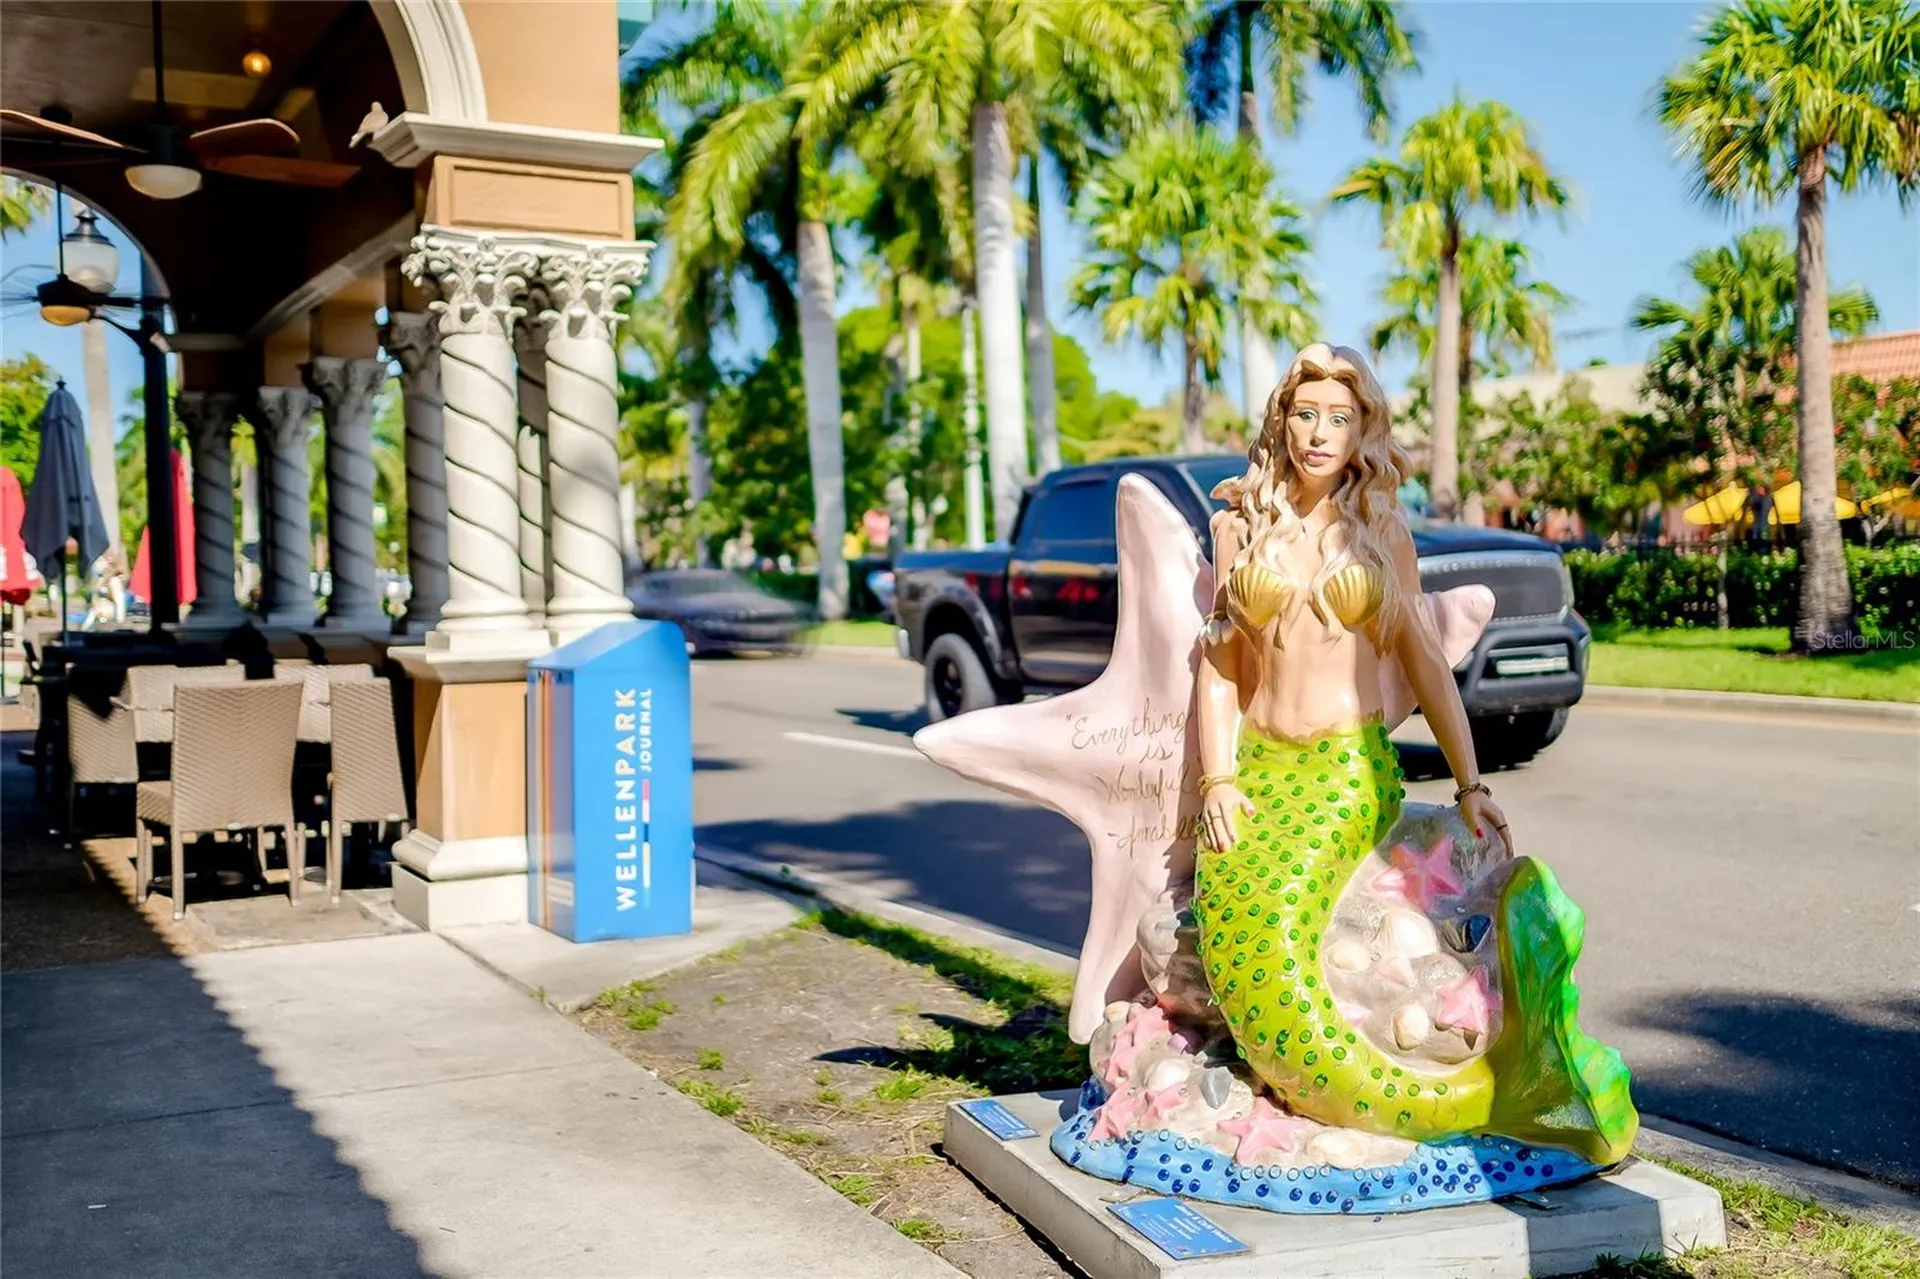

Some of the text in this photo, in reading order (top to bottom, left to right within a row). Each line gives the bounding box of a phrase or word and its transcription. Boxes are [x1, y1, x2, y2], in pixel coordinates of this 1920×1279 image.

[640, 688, 652, 772] JOURNAL
[1139, 742, 1173, 764] is
[614, 688, 637, 912] WELLENPARK
